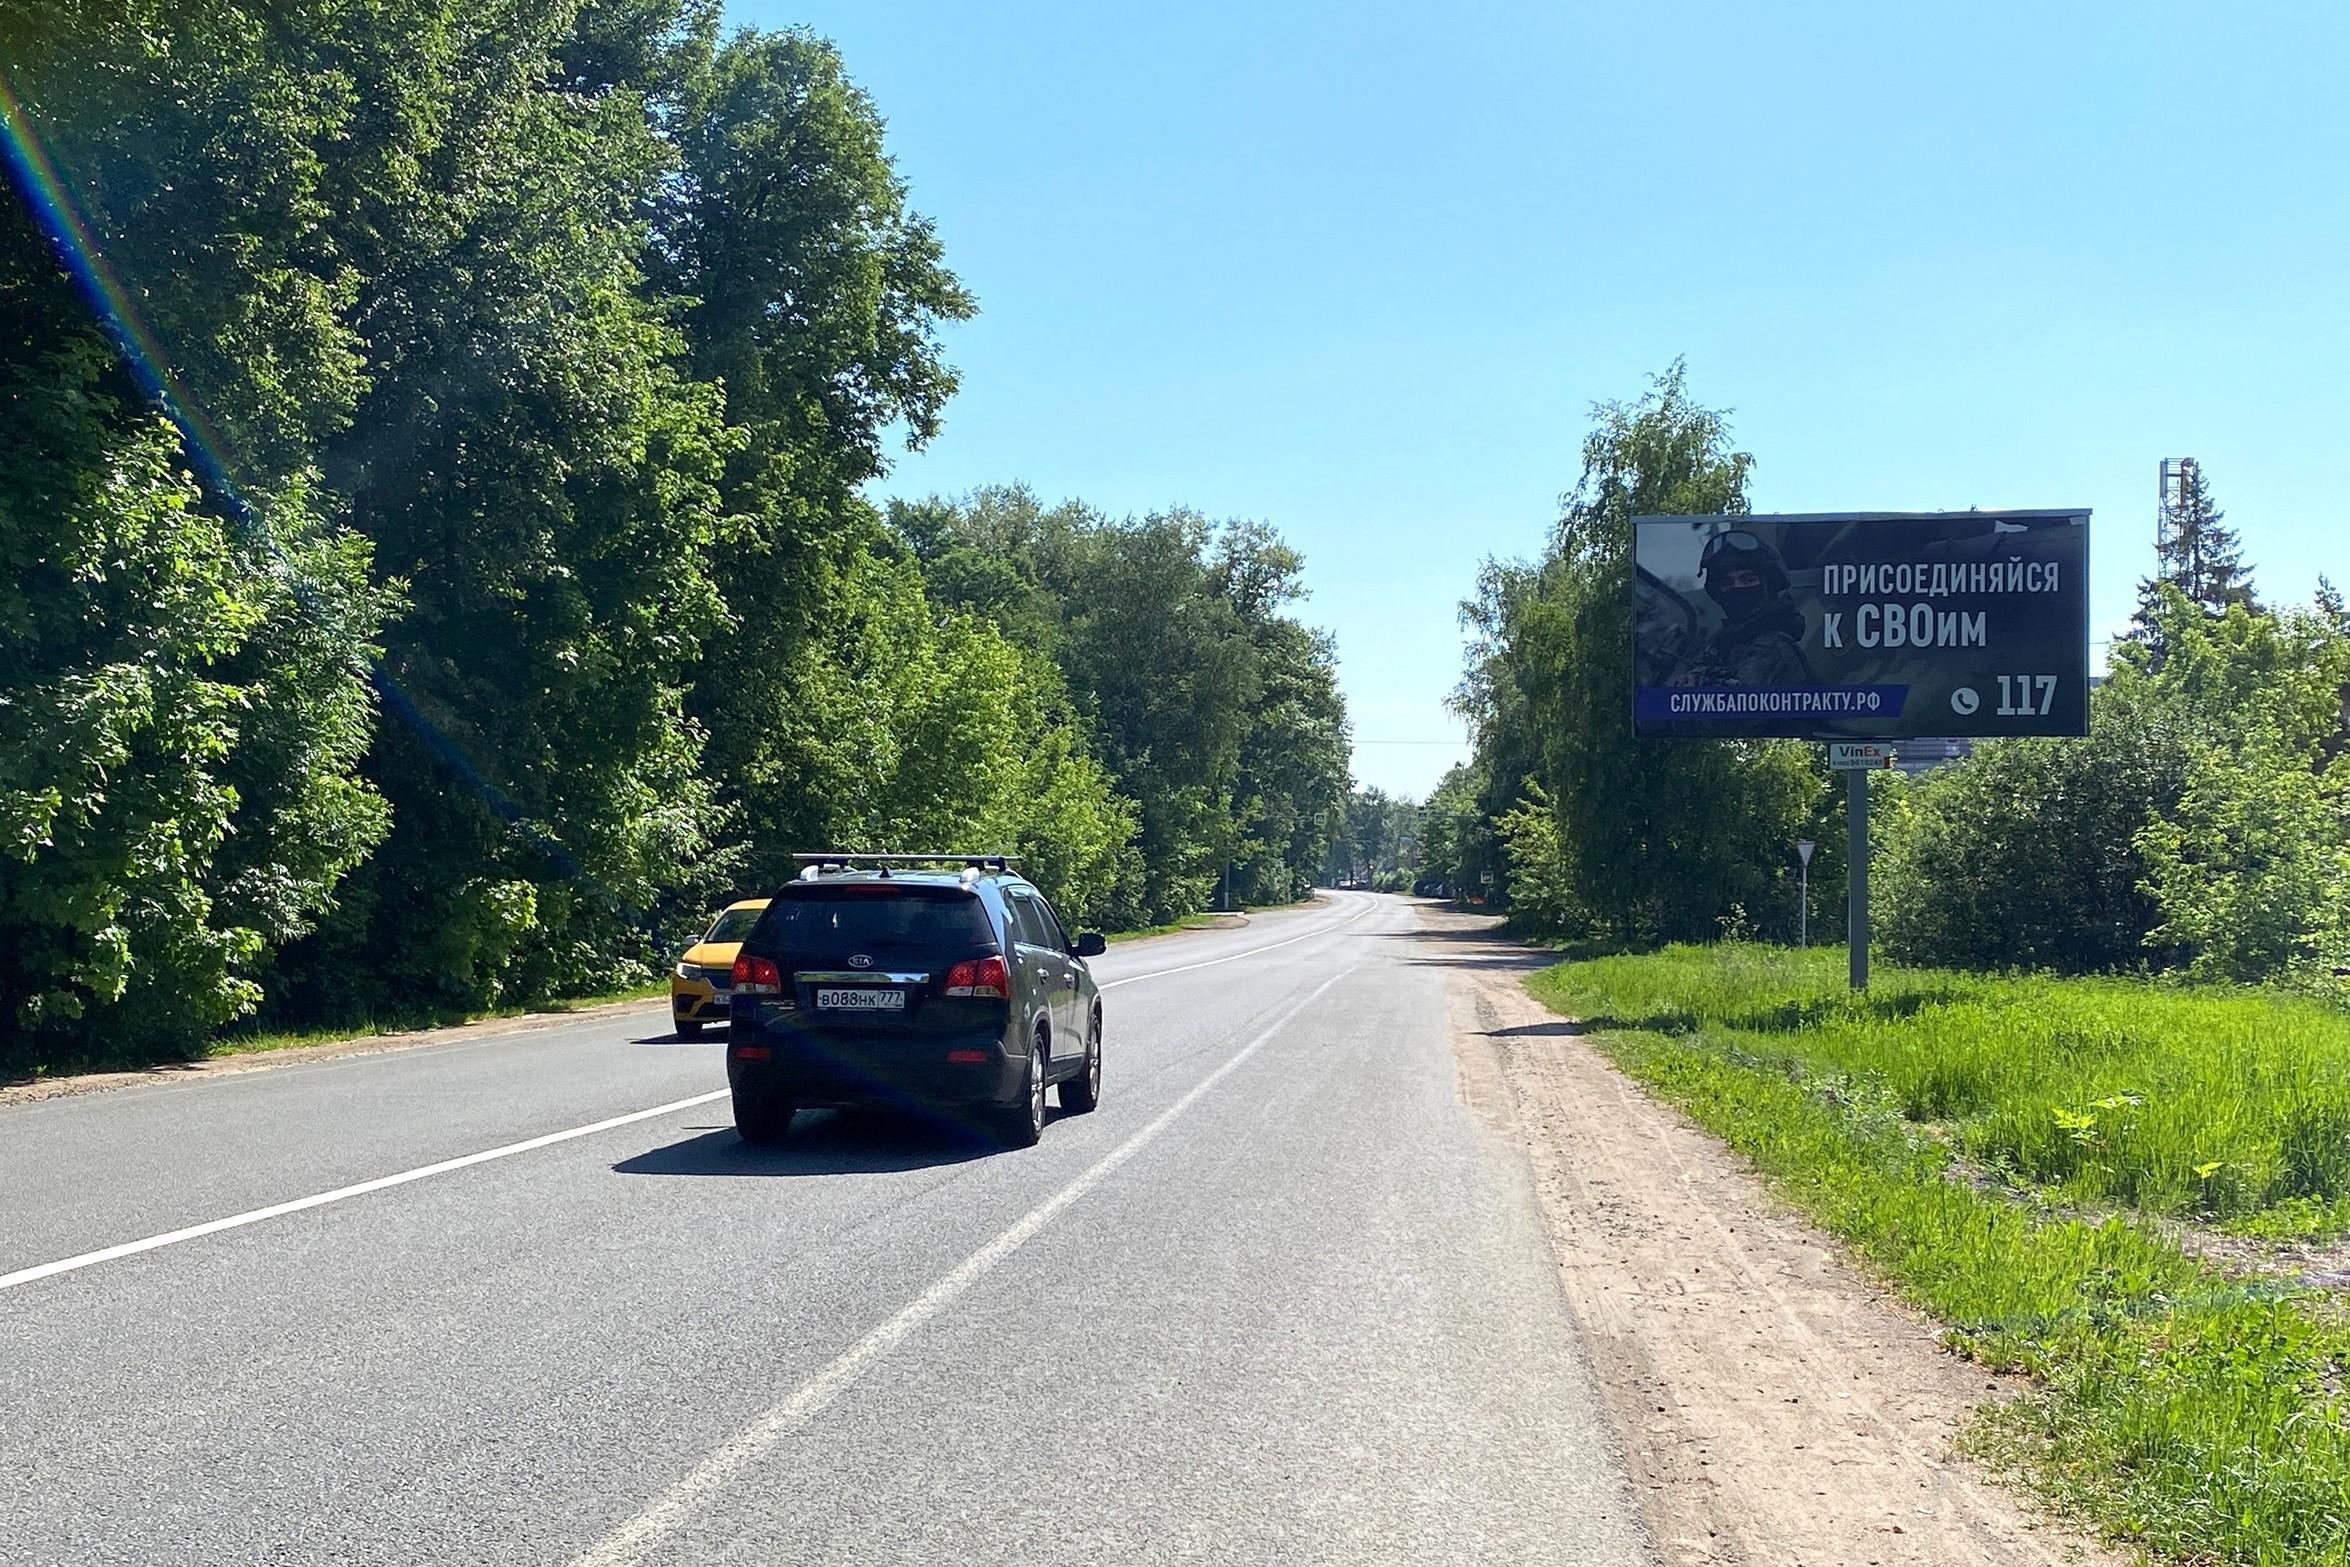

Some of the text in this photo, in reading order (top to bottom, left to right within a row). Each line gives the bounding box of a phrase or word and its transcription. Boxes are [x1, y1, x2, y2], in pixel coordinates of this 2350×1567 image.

[1823, 557, 2060, 596] ПРИСОЕДИНЯЙСЯ
[1670, 691, 1881, 713] СЛУЖБАПОКОНТРАКТУ.РФ
[1997, 675, 2058, 716] 117
[1839, 746, 1881, 757] VinEx
[852, 958, 870, 966] KIA
